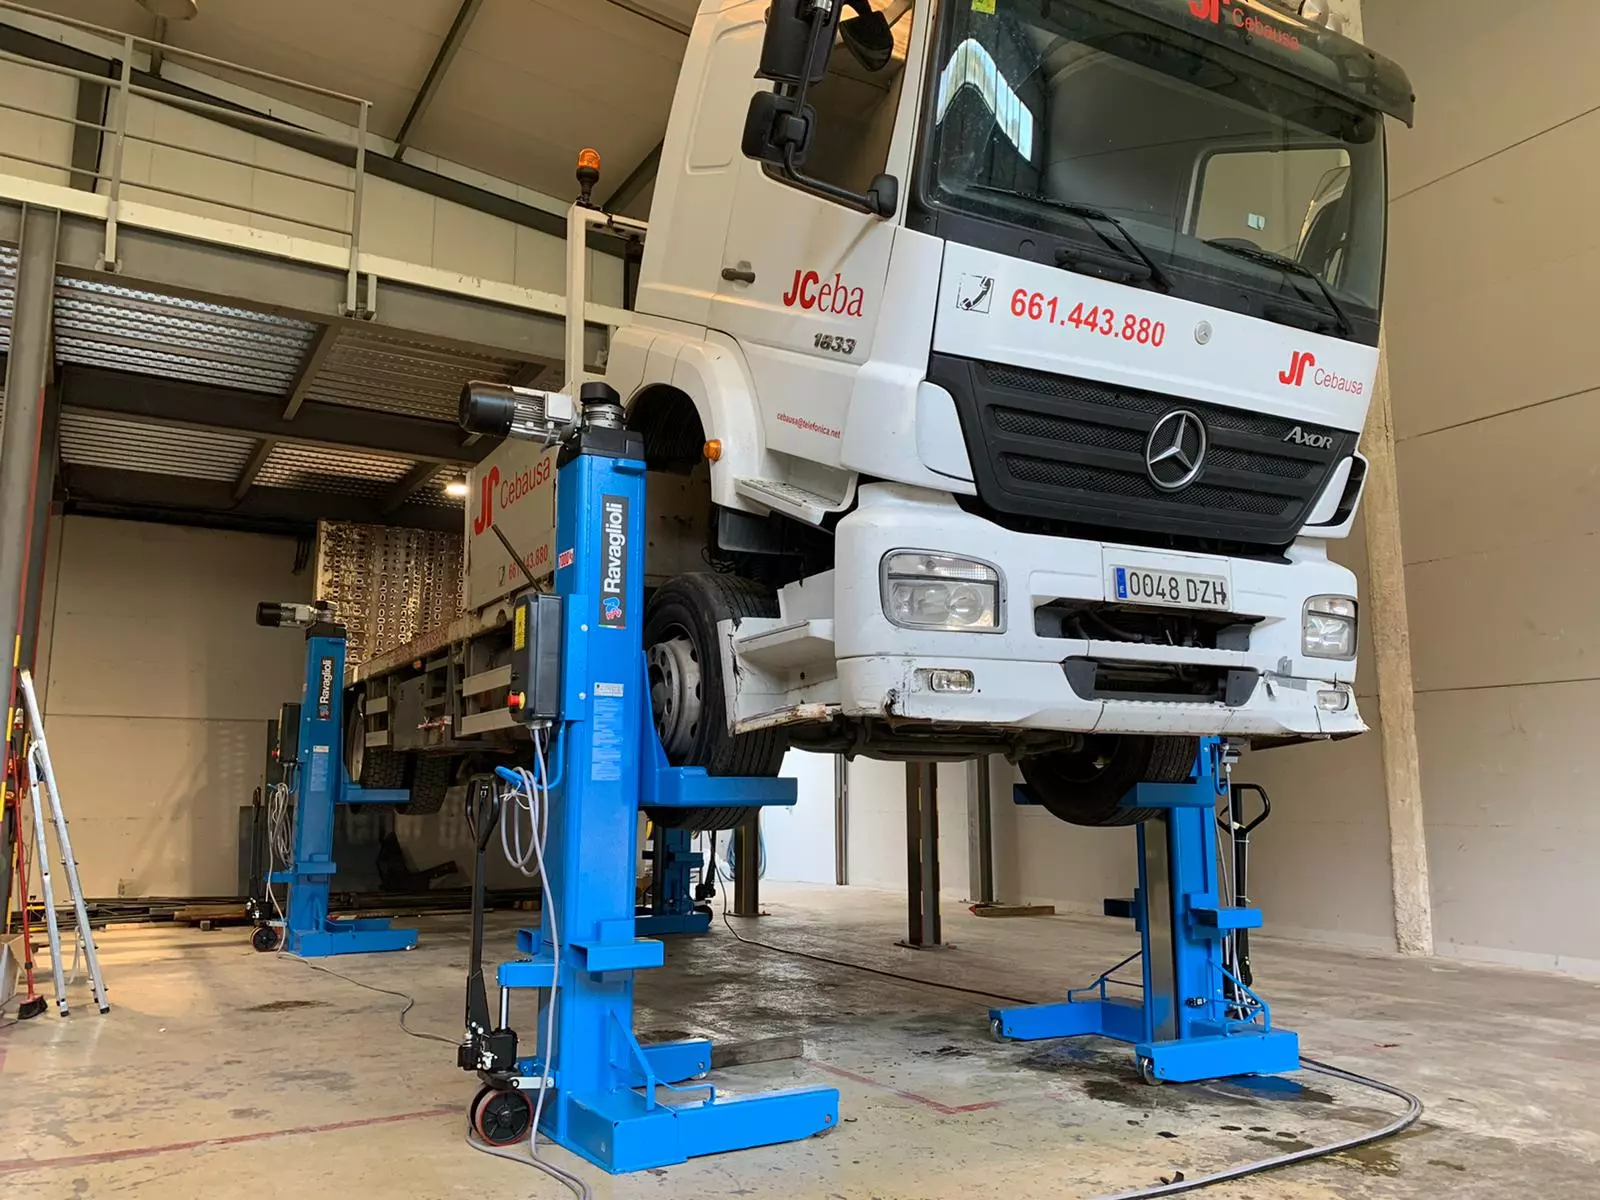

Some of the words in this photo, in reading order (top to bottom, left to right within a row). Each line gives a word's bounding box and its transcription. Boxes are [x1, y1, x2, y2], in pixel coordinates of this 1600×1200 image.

[1231, 7, 1300, 52] Cebausa
[783, 269, 864, 317] JCeba
[1010, 288, 1166, 348] 661.443.880
[1314, 368, 1363, 395] Cebausa
[500, 456, 551, 509] Cebausa
[603, 502, 626, 593] Ravaglioli
[1129, 571, 1180, 601] 0048
[1186, 578, 1227, 605] DZH
[319, 659, 333, 704] Ravaglioli
